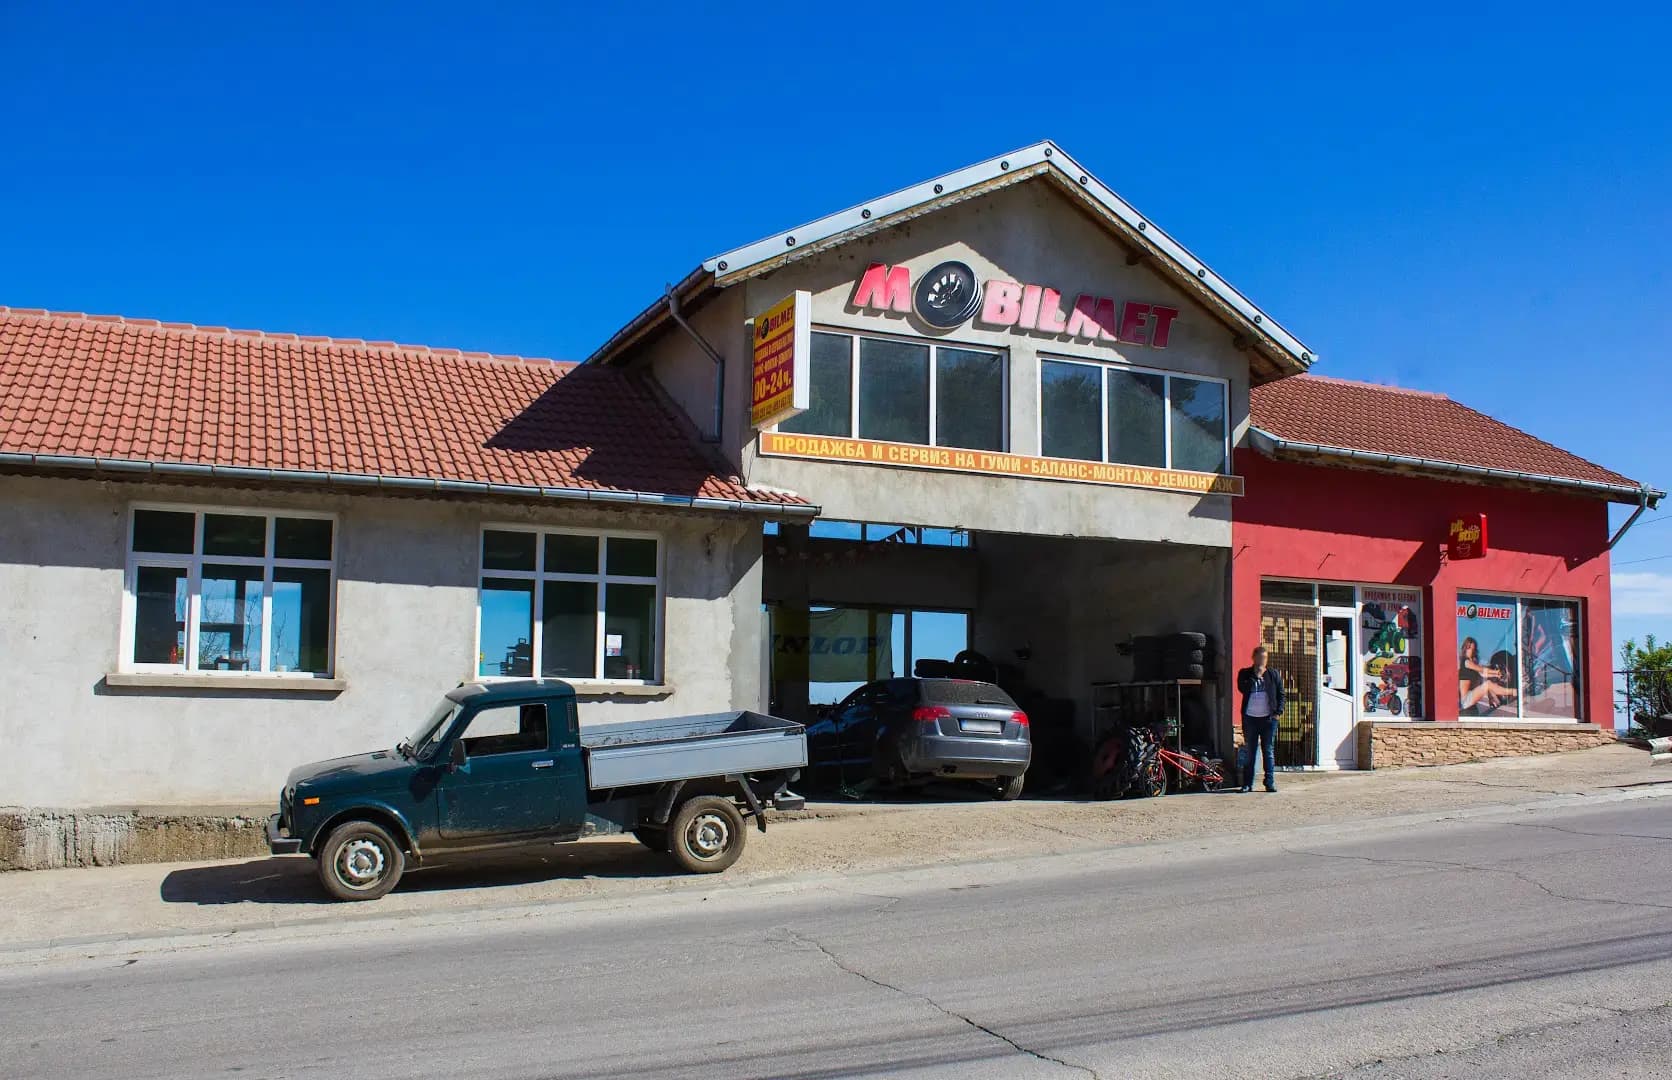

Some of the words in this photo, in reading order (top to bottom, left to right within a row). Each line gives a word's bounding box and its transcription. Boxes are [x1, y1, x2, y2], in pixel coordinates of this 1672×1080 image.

[772, 436, 866, 458] ПРОДАЖБА
[872, 444, 883, 460] И
[888, 445, 950, 466] СЕРВИЗ
[955, 453, 976, 468] НА
[980, 454, 1021, 473] ГУМИ
